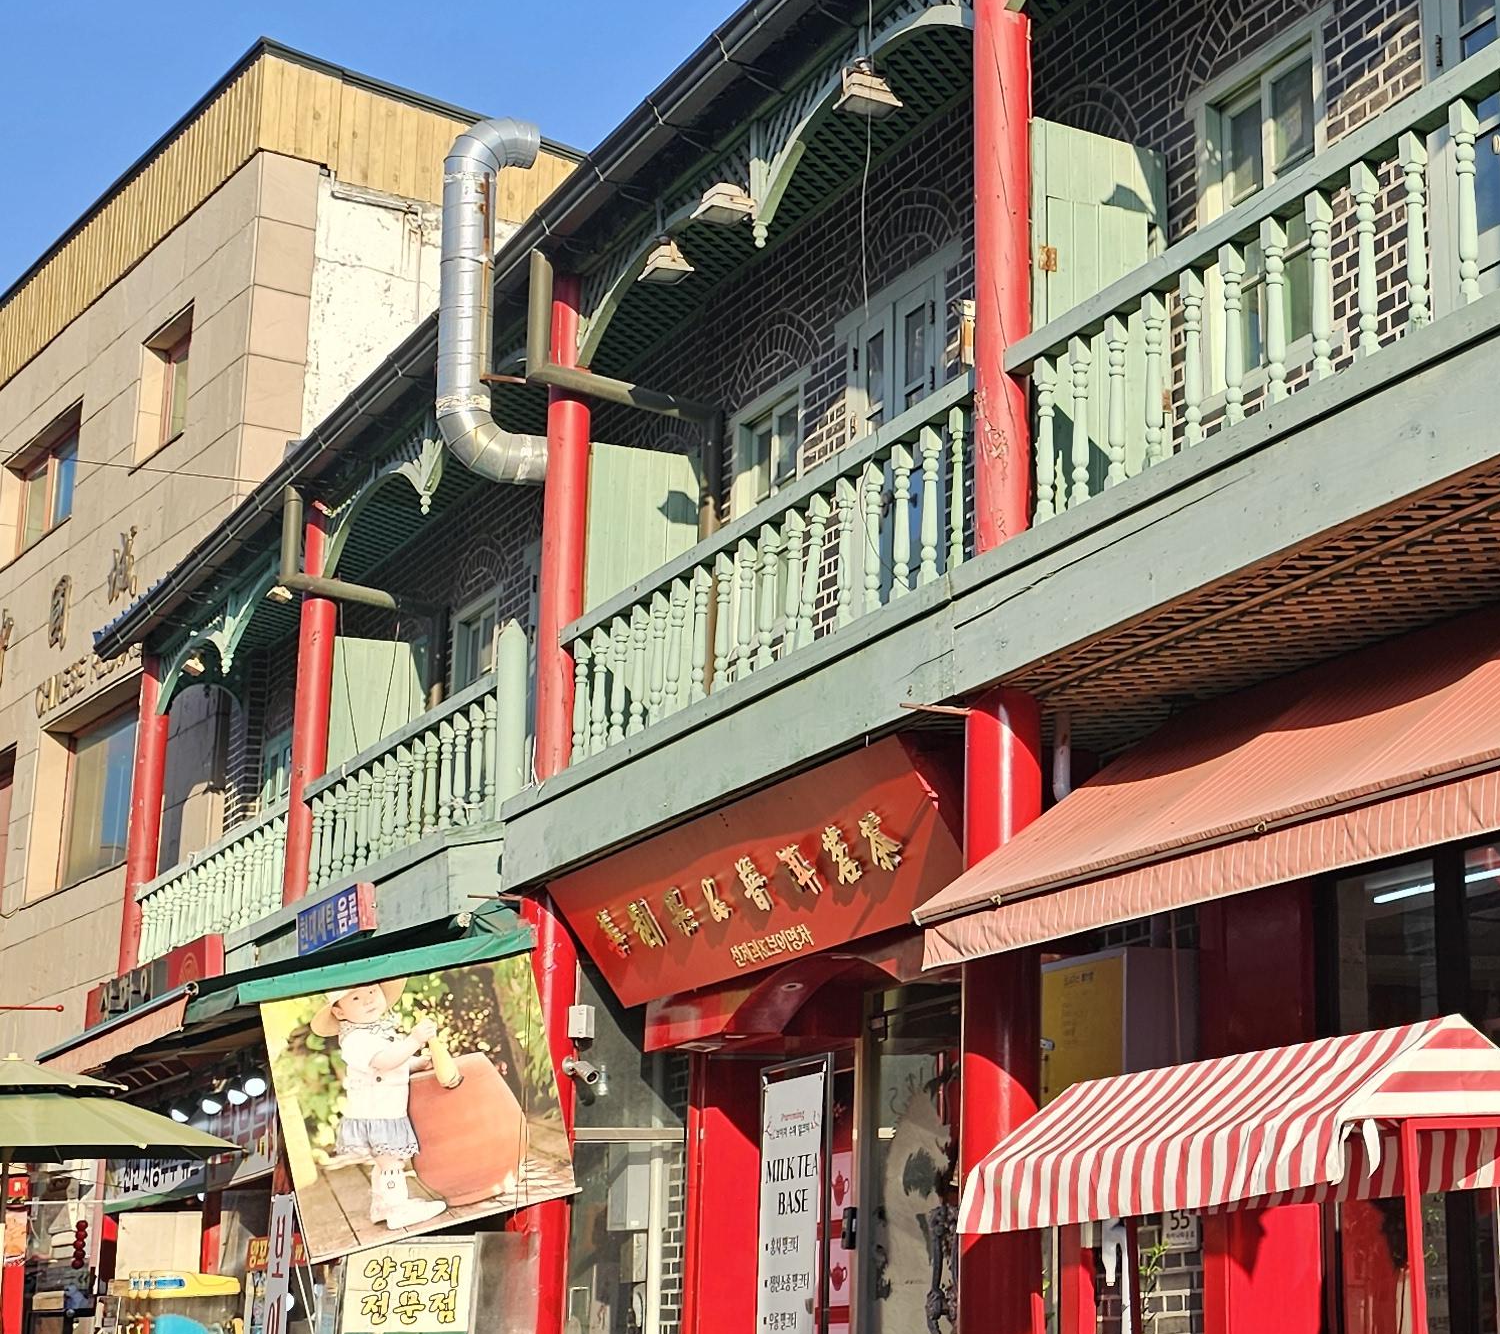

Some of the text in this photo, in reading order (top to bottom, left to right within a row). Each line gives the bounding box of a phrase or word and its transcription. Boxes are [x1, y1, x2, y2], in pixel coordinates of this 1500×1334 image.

[765, 1152, 818, 1184] MILK TEA
[777, 1188, 809, 1216] BASE
[363, 1255, 462, 1292] 양꼬치
[360, 1289, 457, 1326] 전문점
